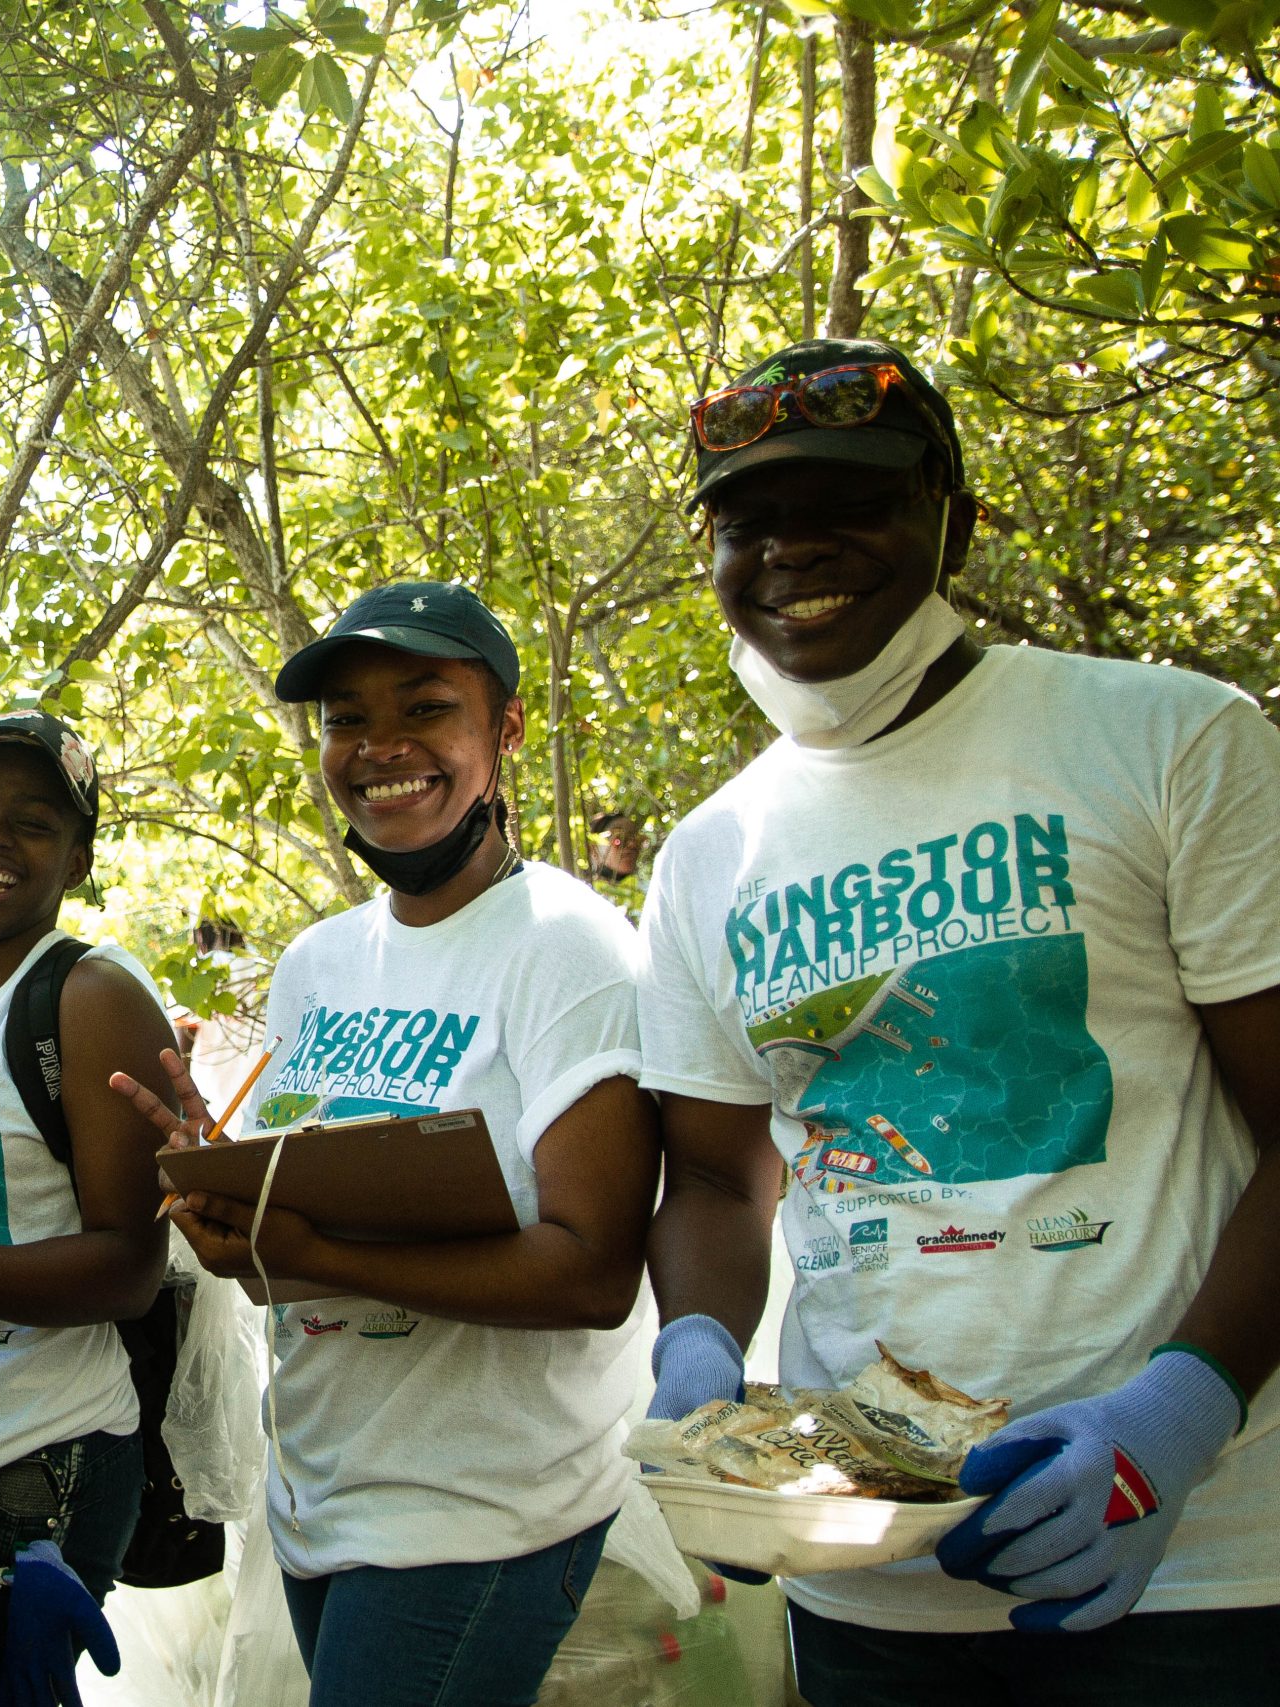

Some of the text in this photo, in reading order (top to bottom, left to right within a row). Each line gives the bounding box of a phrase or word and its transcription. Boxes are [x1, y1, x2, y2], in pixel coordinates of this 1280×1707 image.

[727, 813, 1068, 934] KINGSTON
[738, 877, 767, 903] HE
[725, 855, 1076, 997] HARBOUR
[737, 902, 1076, 1020] CLEANUP PROJECT
[36, 1038, 61, 1101] PINK
[328, 1073, 442, 1104] PROJECT
[835, 1189, 932, 1214] SUPPORTED
[1026, 1214, 1073, 1232] CLEAN
[1028, 1226, 1097, 1245] HARBOURS
[850, 1243, 889, 1256] BENIOFF
[916, 1230, 1006, 1246] GraceKennedy
[796, 1251, 840, 1271] CLEANUP
[851, 1253, 890, 1265] OCEAN
